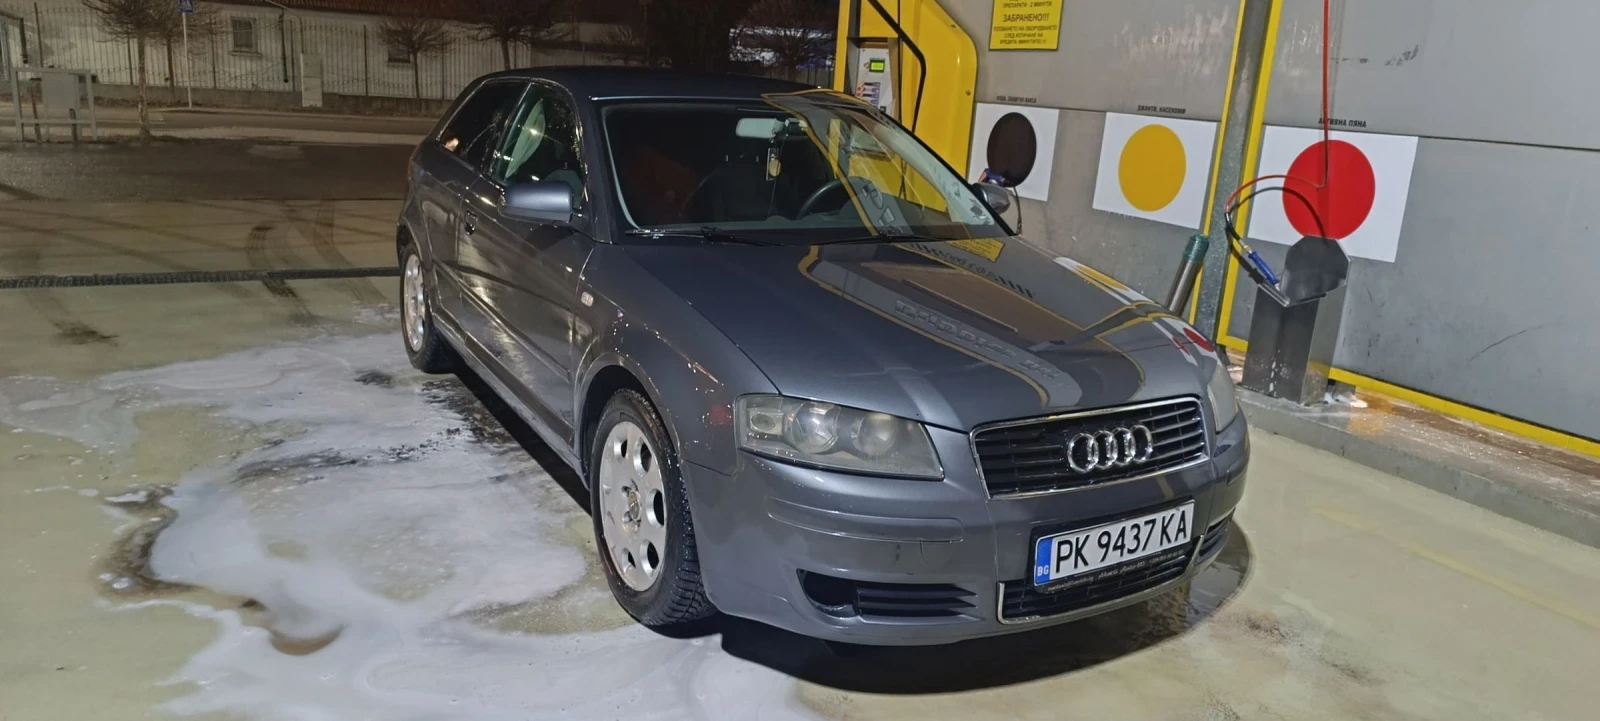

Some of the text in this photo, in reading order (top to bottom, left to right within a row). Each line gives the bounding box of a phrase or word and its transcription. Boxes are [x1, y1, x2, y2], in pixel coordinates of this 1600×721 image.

[1003, 12, 1050, 22] ЗАБРАНЕНО!!!
[1318, 117, 1367, 128] АТИВНА ПЯНА
[1055, 534, 1090, 574] PK
[1097, 518, 1157, 562] 9437
[1159, 510, 1187, 547] KA
[1037, 565, 1049, 577] BG
